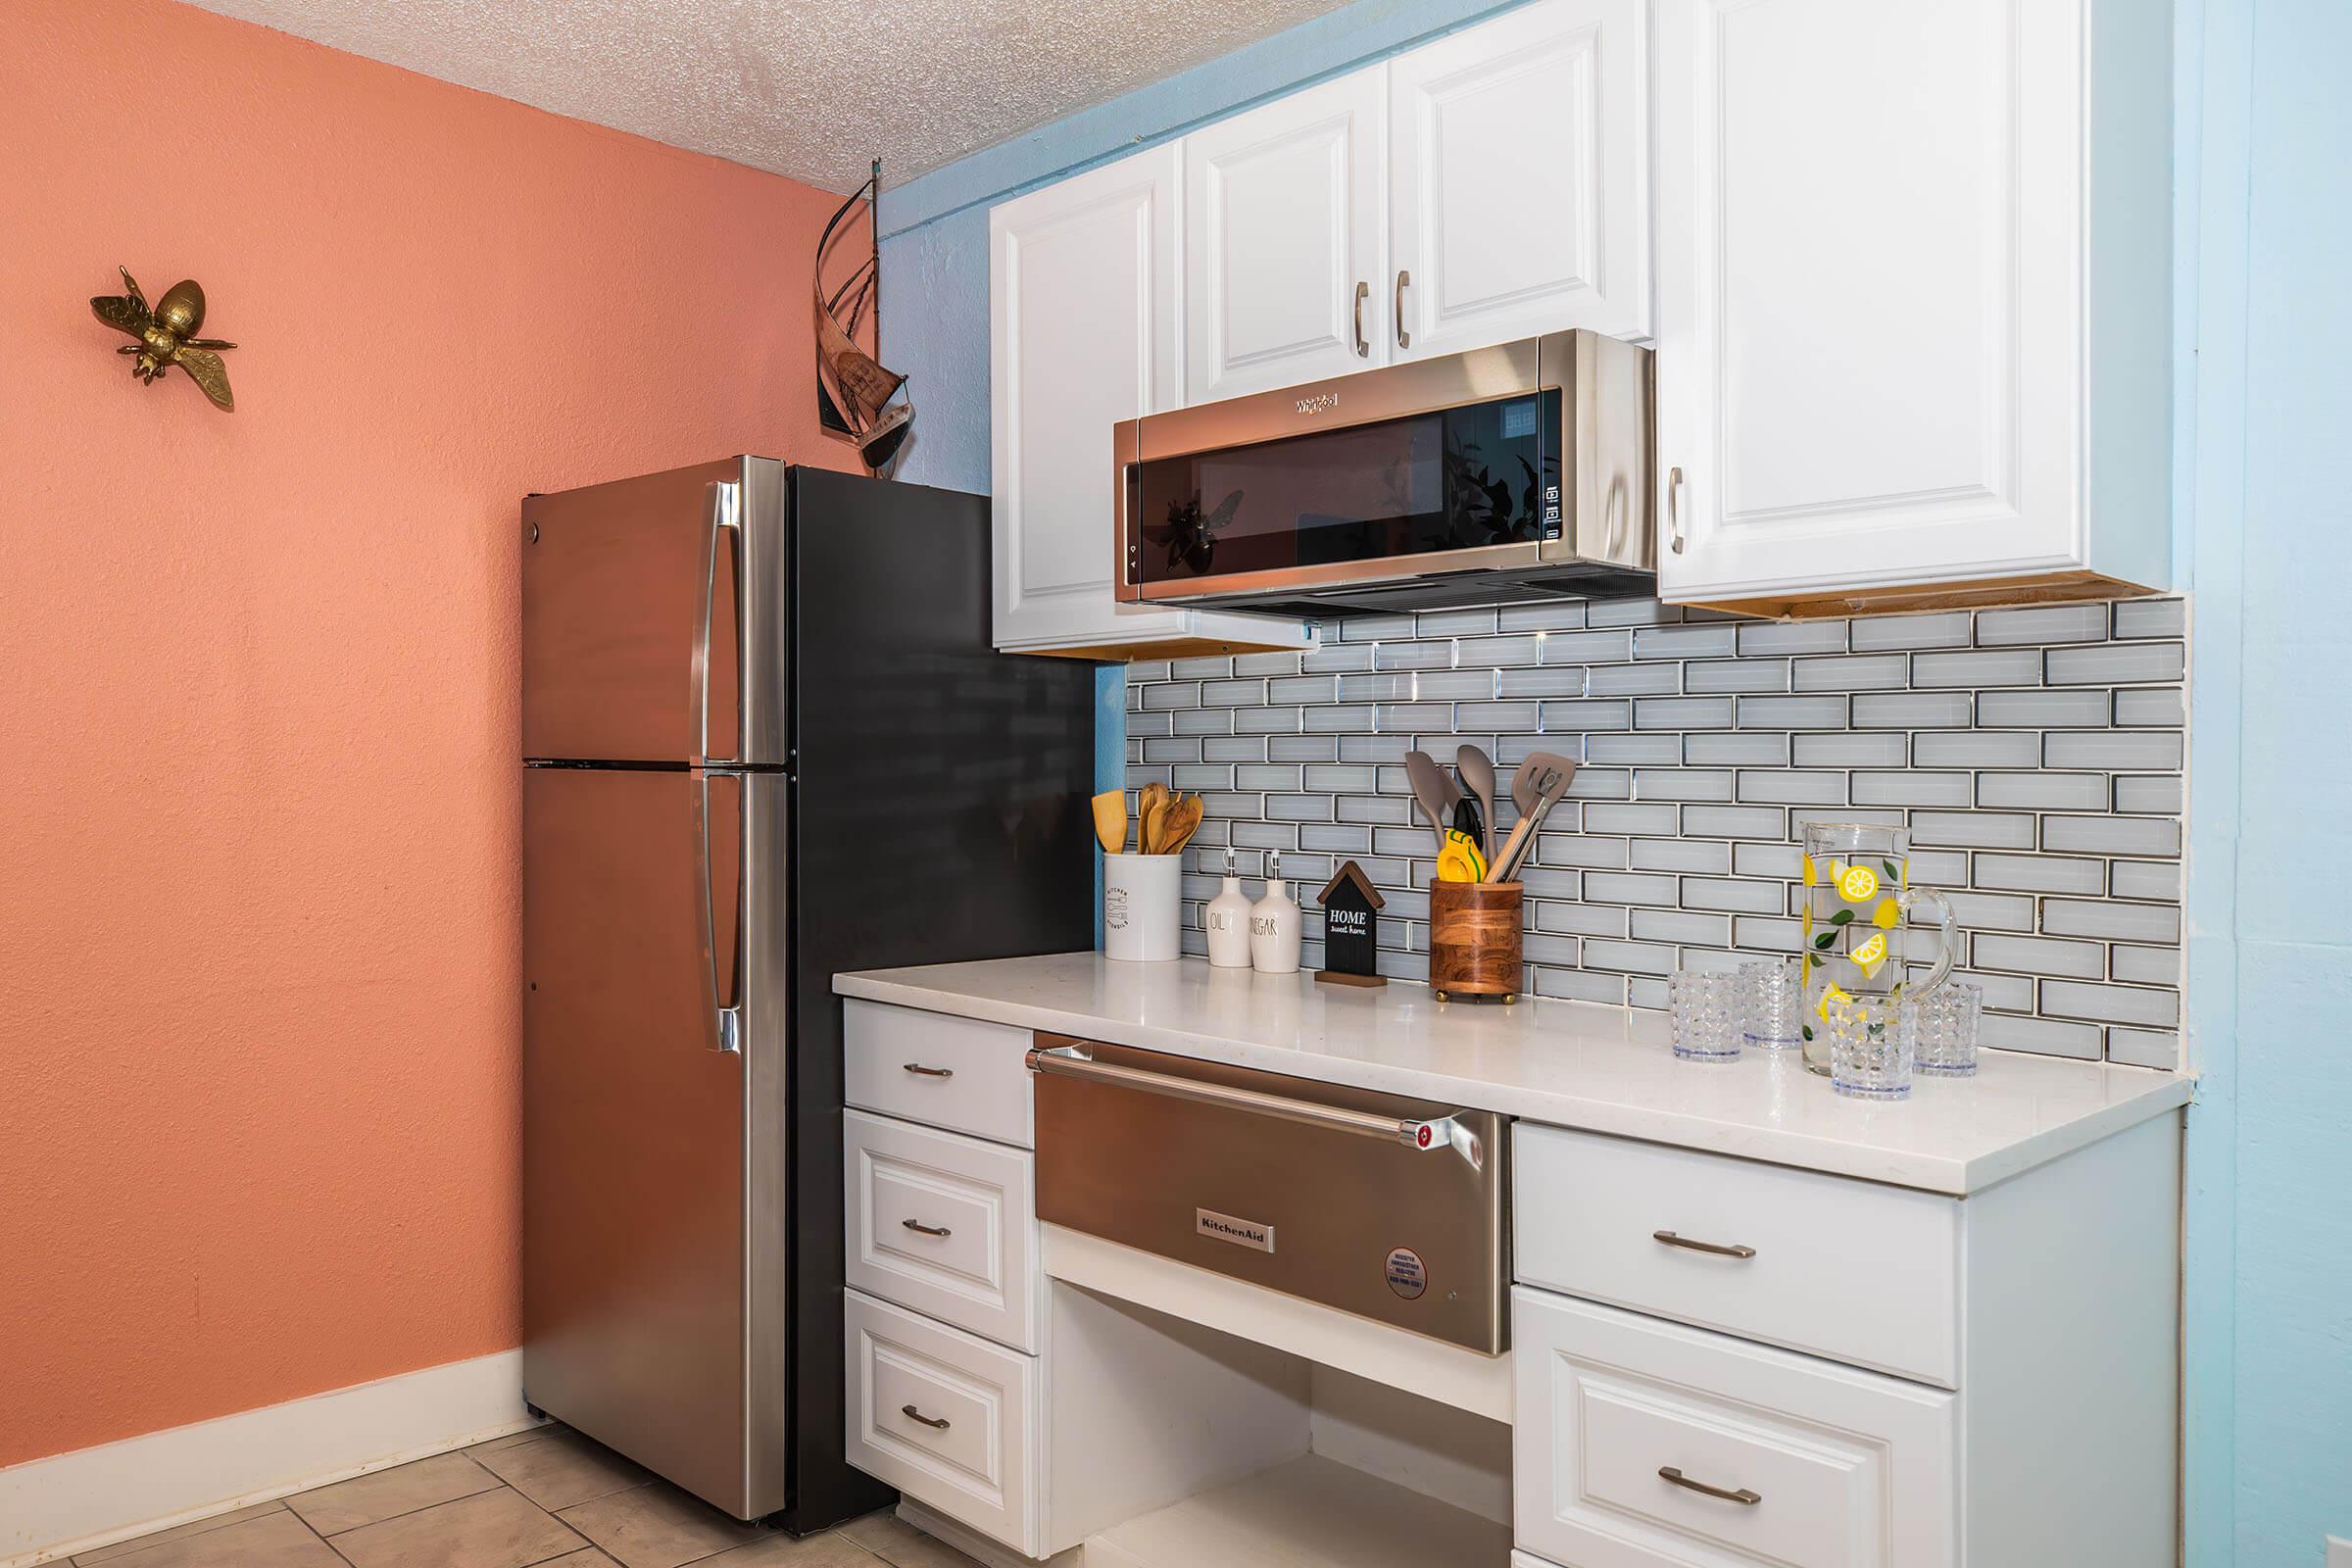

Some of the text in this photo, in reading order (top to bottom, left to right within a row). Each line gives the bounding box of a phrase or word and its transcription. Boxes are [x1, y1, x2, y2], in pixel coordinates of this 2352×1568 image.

[1296, 393, 1338, 414] Whirlpool
[1210, 912, 1225, 930] OIL
[1330, 909, 1367, 925] HOME
[1331, 925, 1366, 935] sweet home
[1201, 1217, 1264, 1243] KitchenAid
